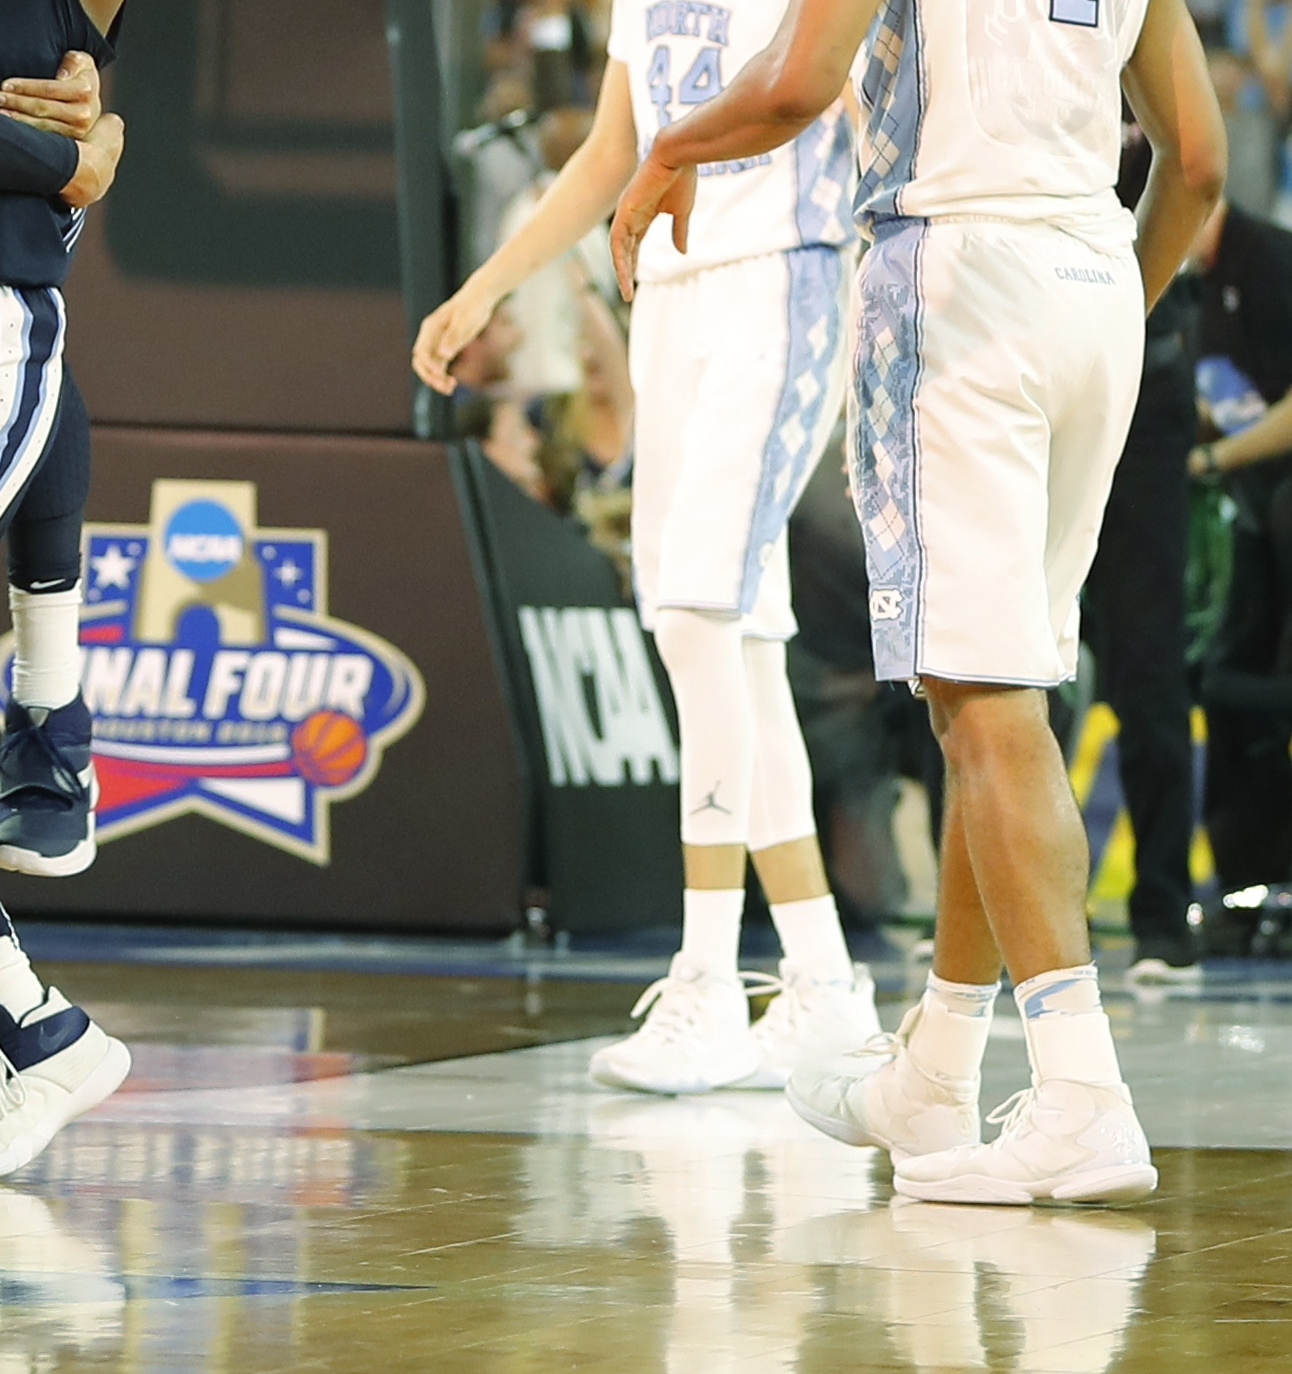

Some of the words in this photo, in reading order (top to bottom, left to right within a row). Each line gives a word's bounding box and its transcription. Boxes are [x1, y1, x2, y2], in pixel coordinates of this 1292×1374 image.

[1054, 267, 1117, 286] CAROLINA
[77, 644, 198, 720] NAL
[202, 648, 375, 724] FOUR
[518, 604, 681, 787] NCAA
